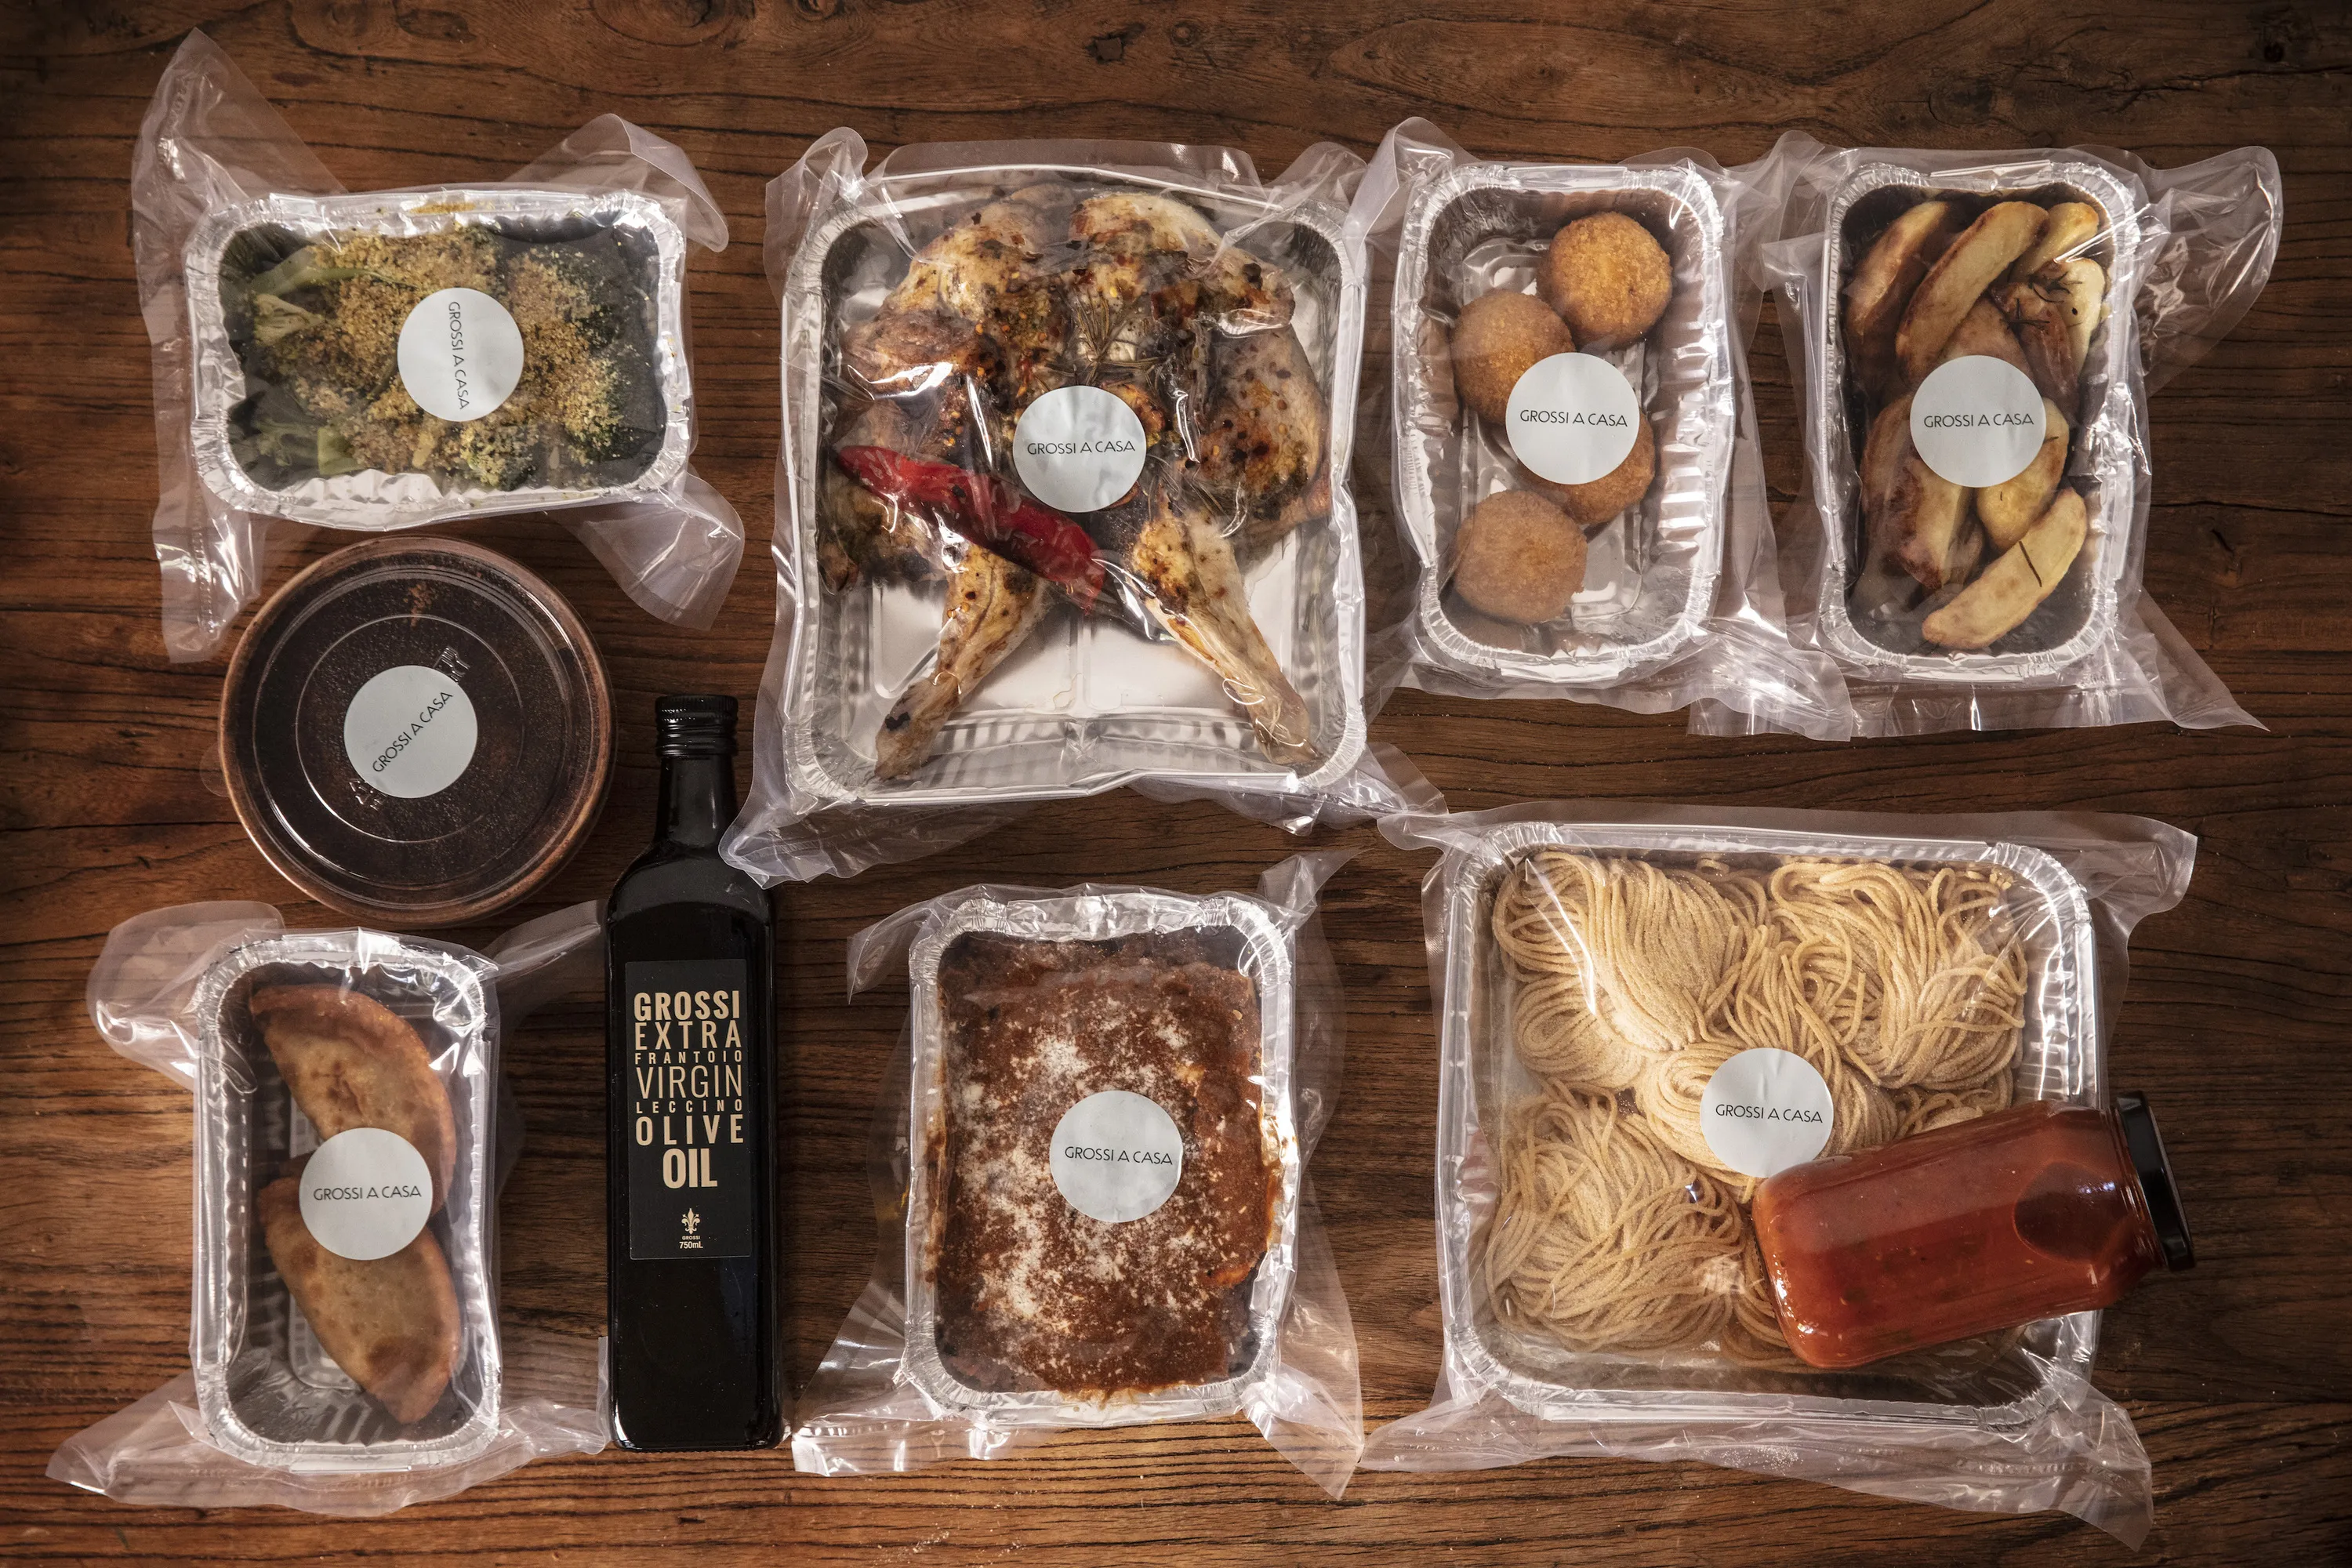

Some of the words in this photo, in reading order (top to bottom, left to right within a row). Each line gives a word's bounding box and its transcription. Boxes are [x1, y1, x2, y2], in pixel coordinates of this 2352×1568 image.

[448, 301, 464, 351] GROSSI
[452, 354, 465, 368] A
[454, 368, 470, 410] CASA
[1519, 409, 1570, 424] GROSSI
[1572, 412, 1585, 425] A
[1588, 412, 1628, 427] CASA
[1923, 414, 1974, 428] GROSSI
[1977, 414, 1991, 426] A
[1993, 412, 2034, 426] CASA
[1027, 442, 1076, 456] GROSSI
[1080, 441, 1093, 454] A
[1094, 440, 1136, 453] CASA
[372, 731, 413, 772] GROSSI
[410, 723, 424, 736] A
[419, 691, 453, 724] CASA
[633, 990, 740, 1021] GROSSI
[634, 1019, 742, 1051] EXTRA
[634, 1050, 742, 1065] FRANTOIO
[635, 1065, 742, 1099] VIRGIN
[636, 1098, 742, 1114] LECCINO
[1715, 1103, 1764, 1120] GROSSI
[1767, 1107, 1780, 1121] A
[1783, 1109, 1824, 1123] CASA
[635, 1114, 744, 1146] OLIVE
[1064, 1145, 1114, 1162] GROSSI
[1116, 1149, 1131, 1163] A
[1132, 1150, 1174, 1166] CASA
[662, 1148, 718, 1189] OIL
[313, 1187, 363, 1201] GROSSI
[366, 1186, 379, 1199] A
[381, 1185, 422, 1199] CASA
